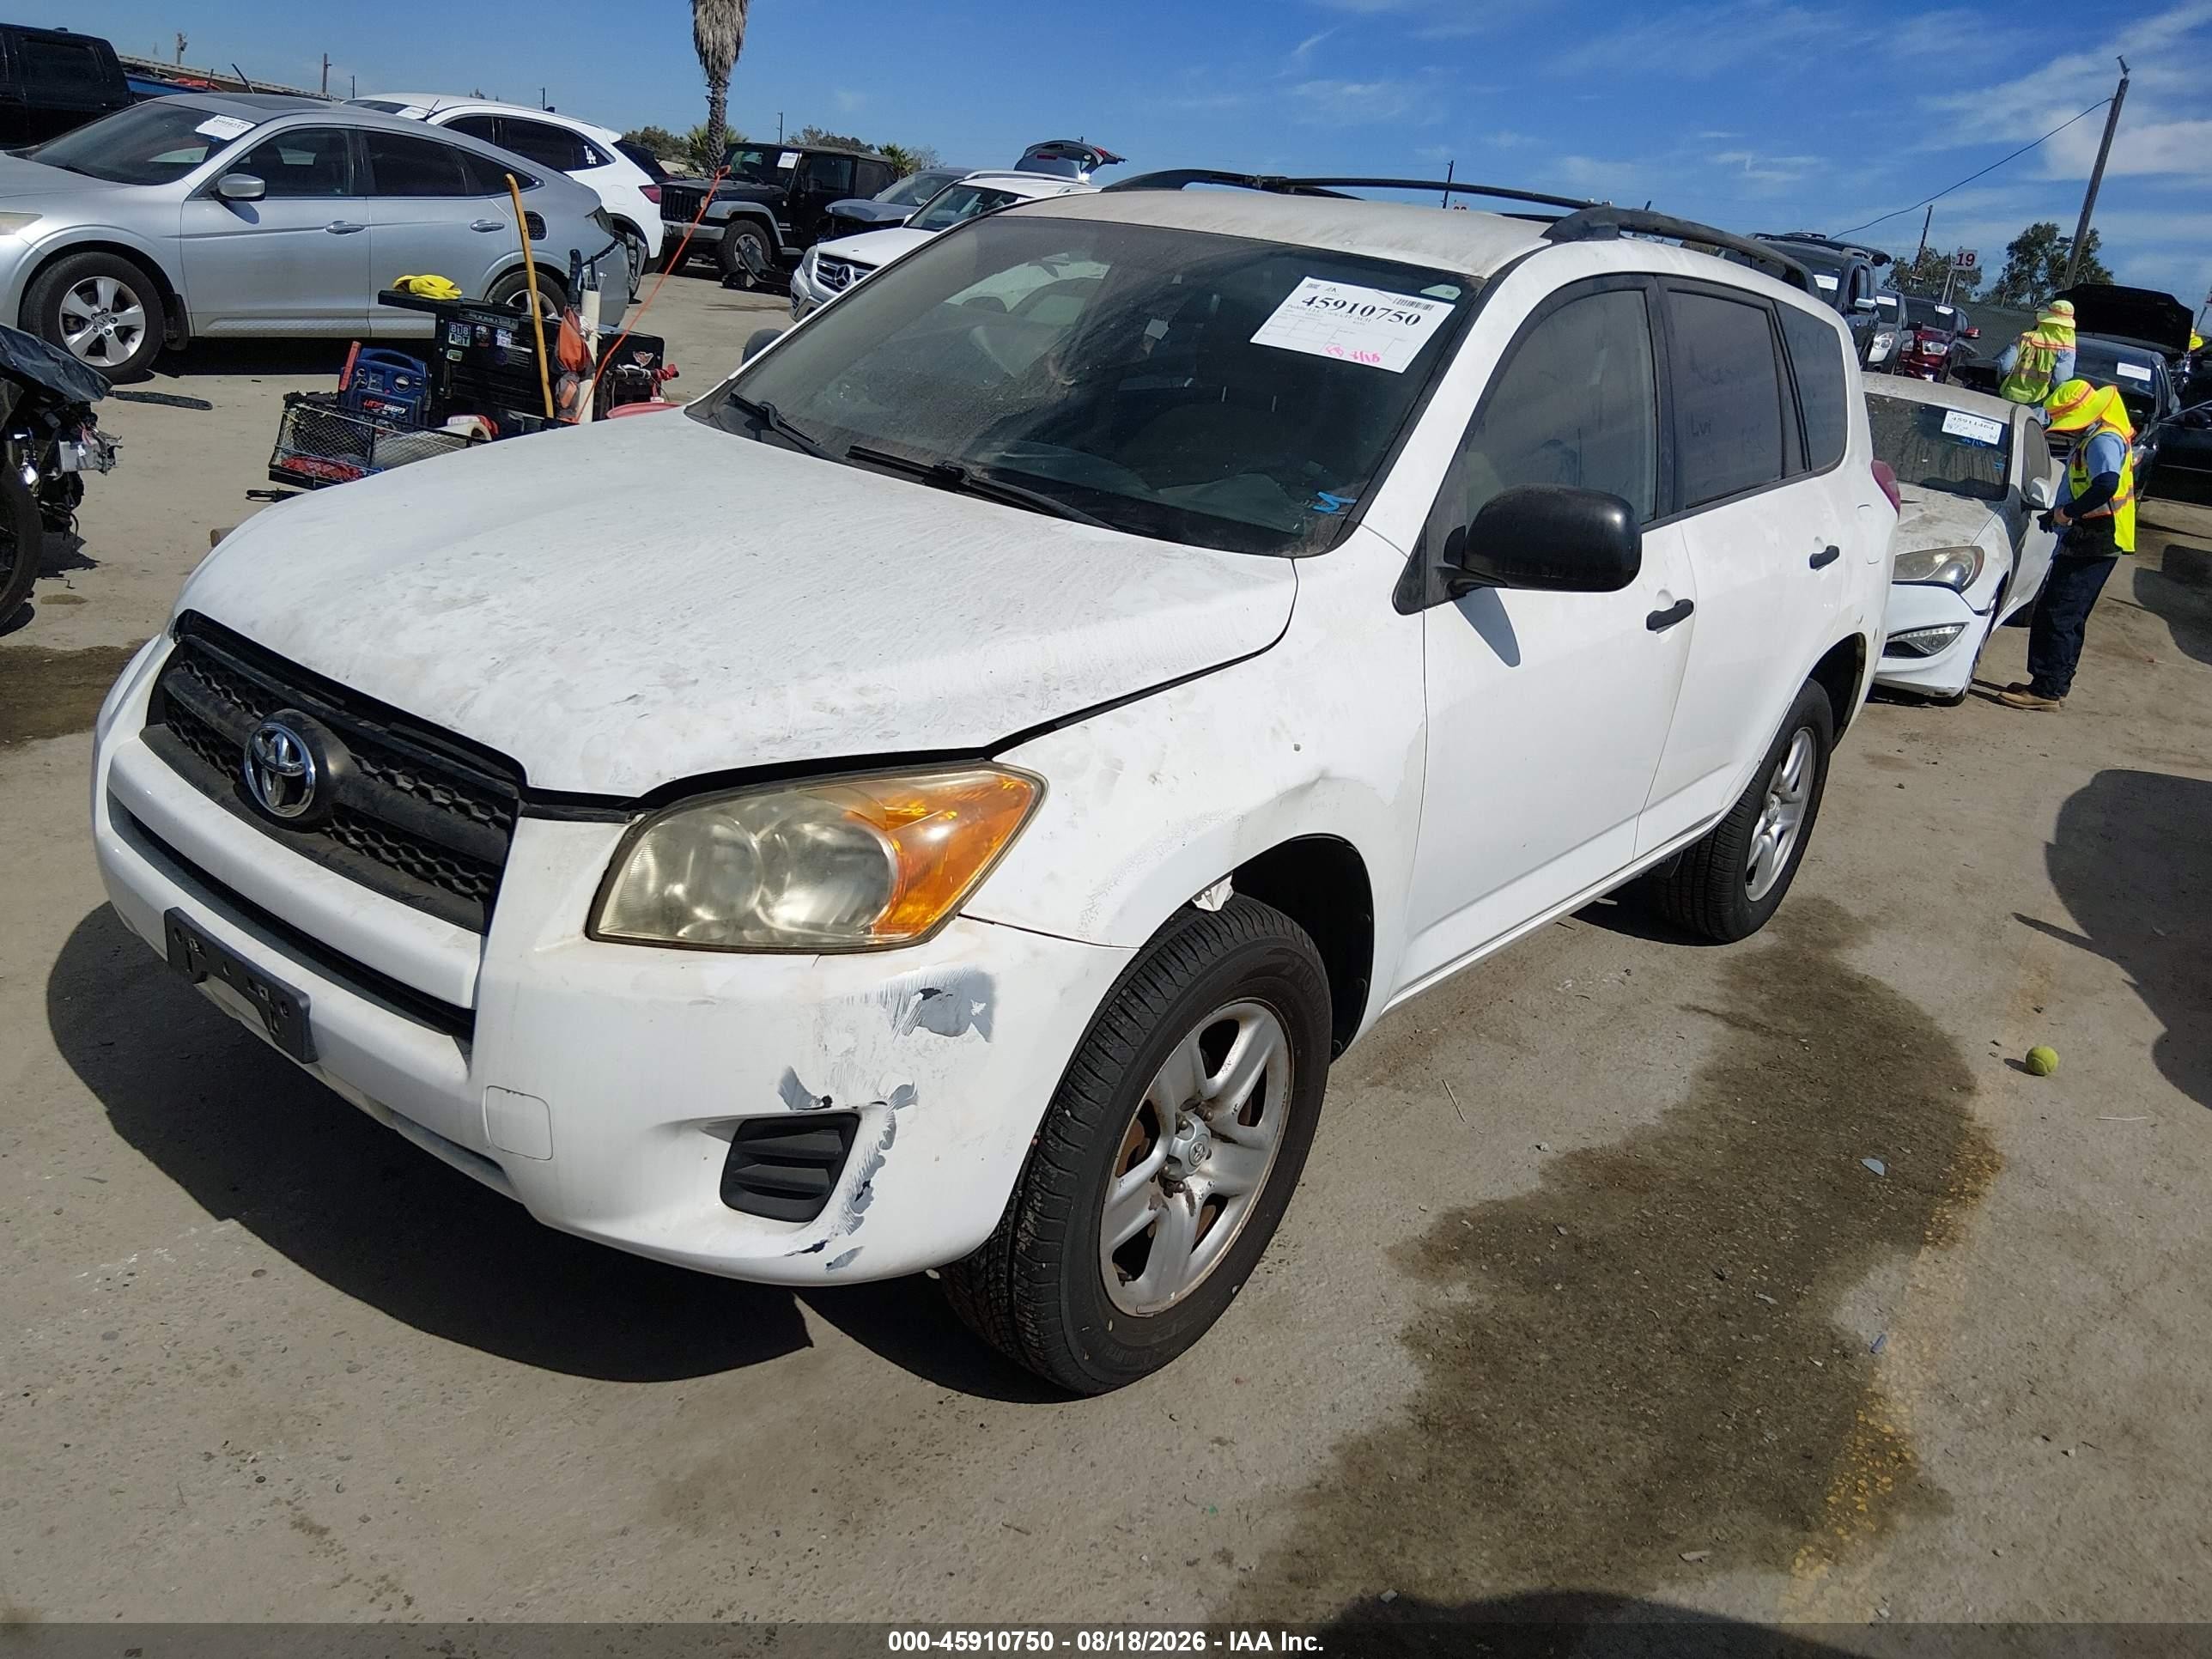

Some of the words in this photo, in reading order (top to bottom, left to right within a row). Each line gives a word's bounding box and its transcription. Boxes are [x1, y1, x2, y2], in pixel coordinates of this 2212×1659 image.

[583, 145, 597, 164] LA
[1955, 252, 1975, 266] 19
[1302, 295, 1421, 325] 45910750
[449, 332, 470, 346] ART
